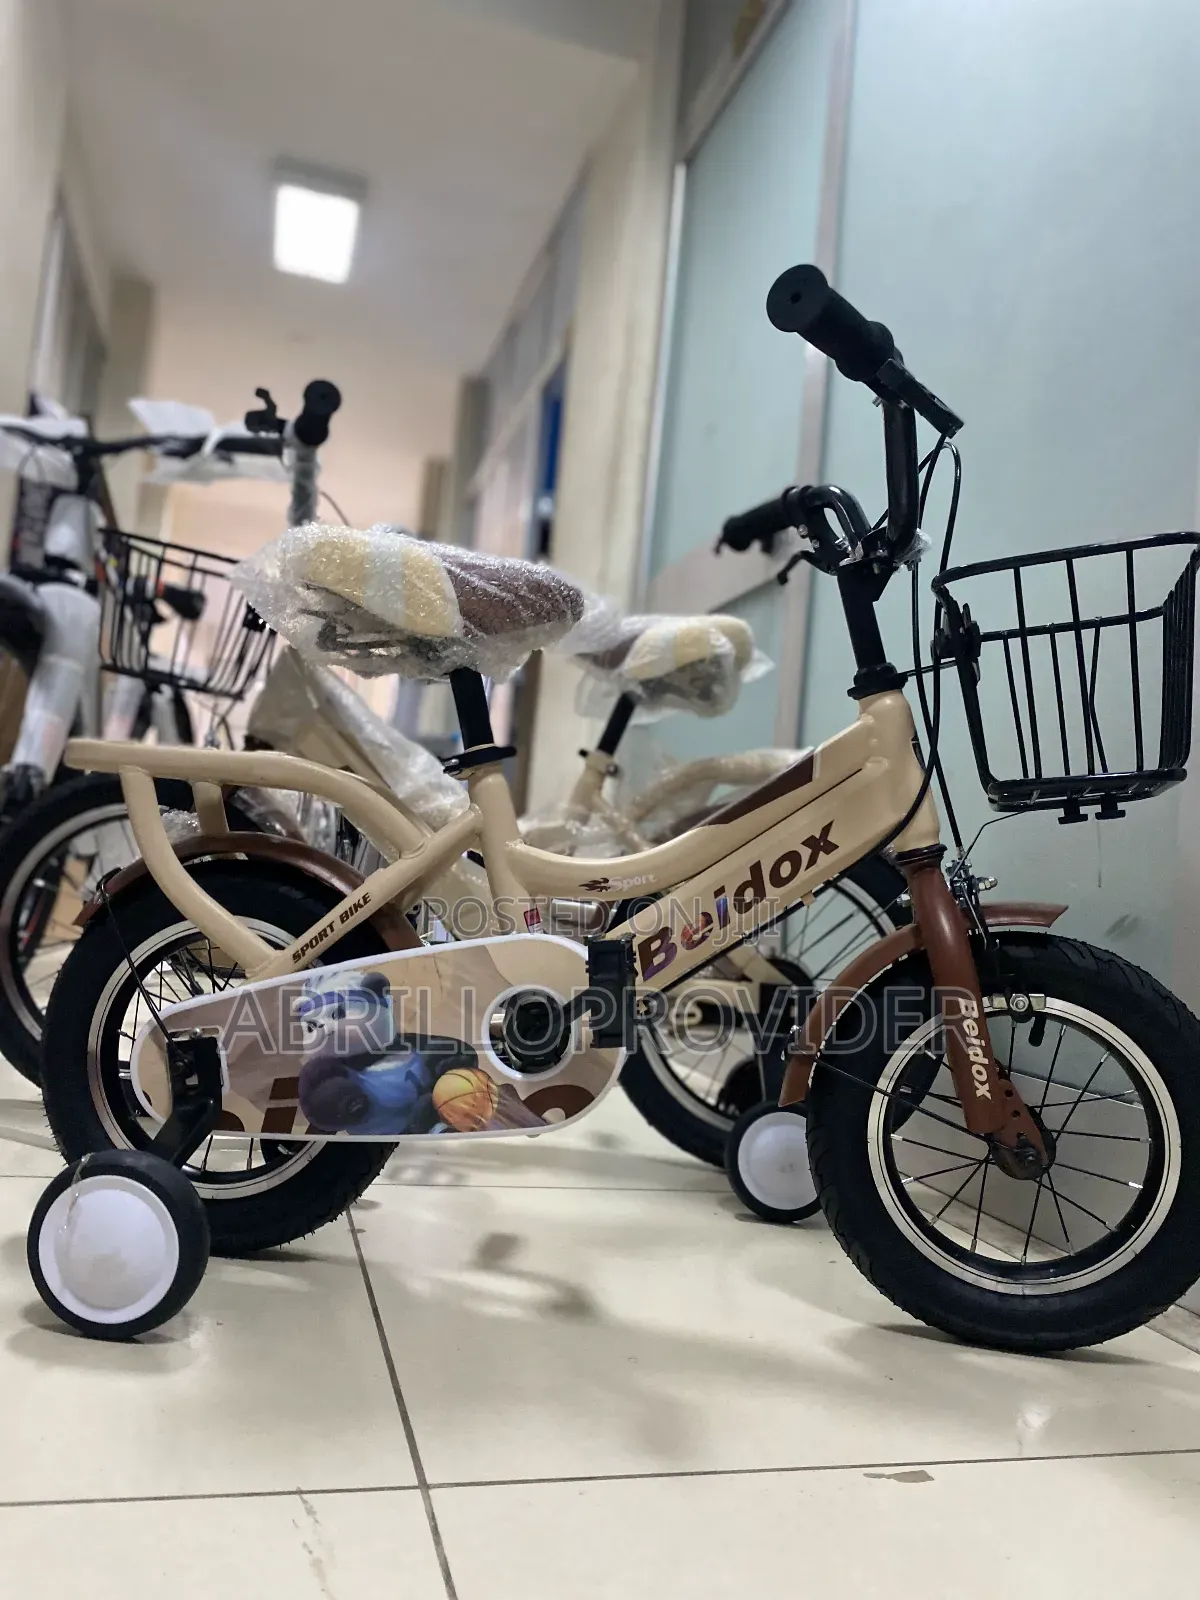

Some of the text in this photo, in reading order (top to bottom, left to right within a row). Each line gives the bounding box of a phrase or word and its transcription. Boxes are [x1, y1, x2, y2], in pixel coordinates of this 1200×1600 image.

[608, 873, 658, 892] Sport
[637, 819, 840, 983] Beidox
[292, 892, 371, 964] SPORT BIKE
[958, 998, 992, 1100] Beidox
